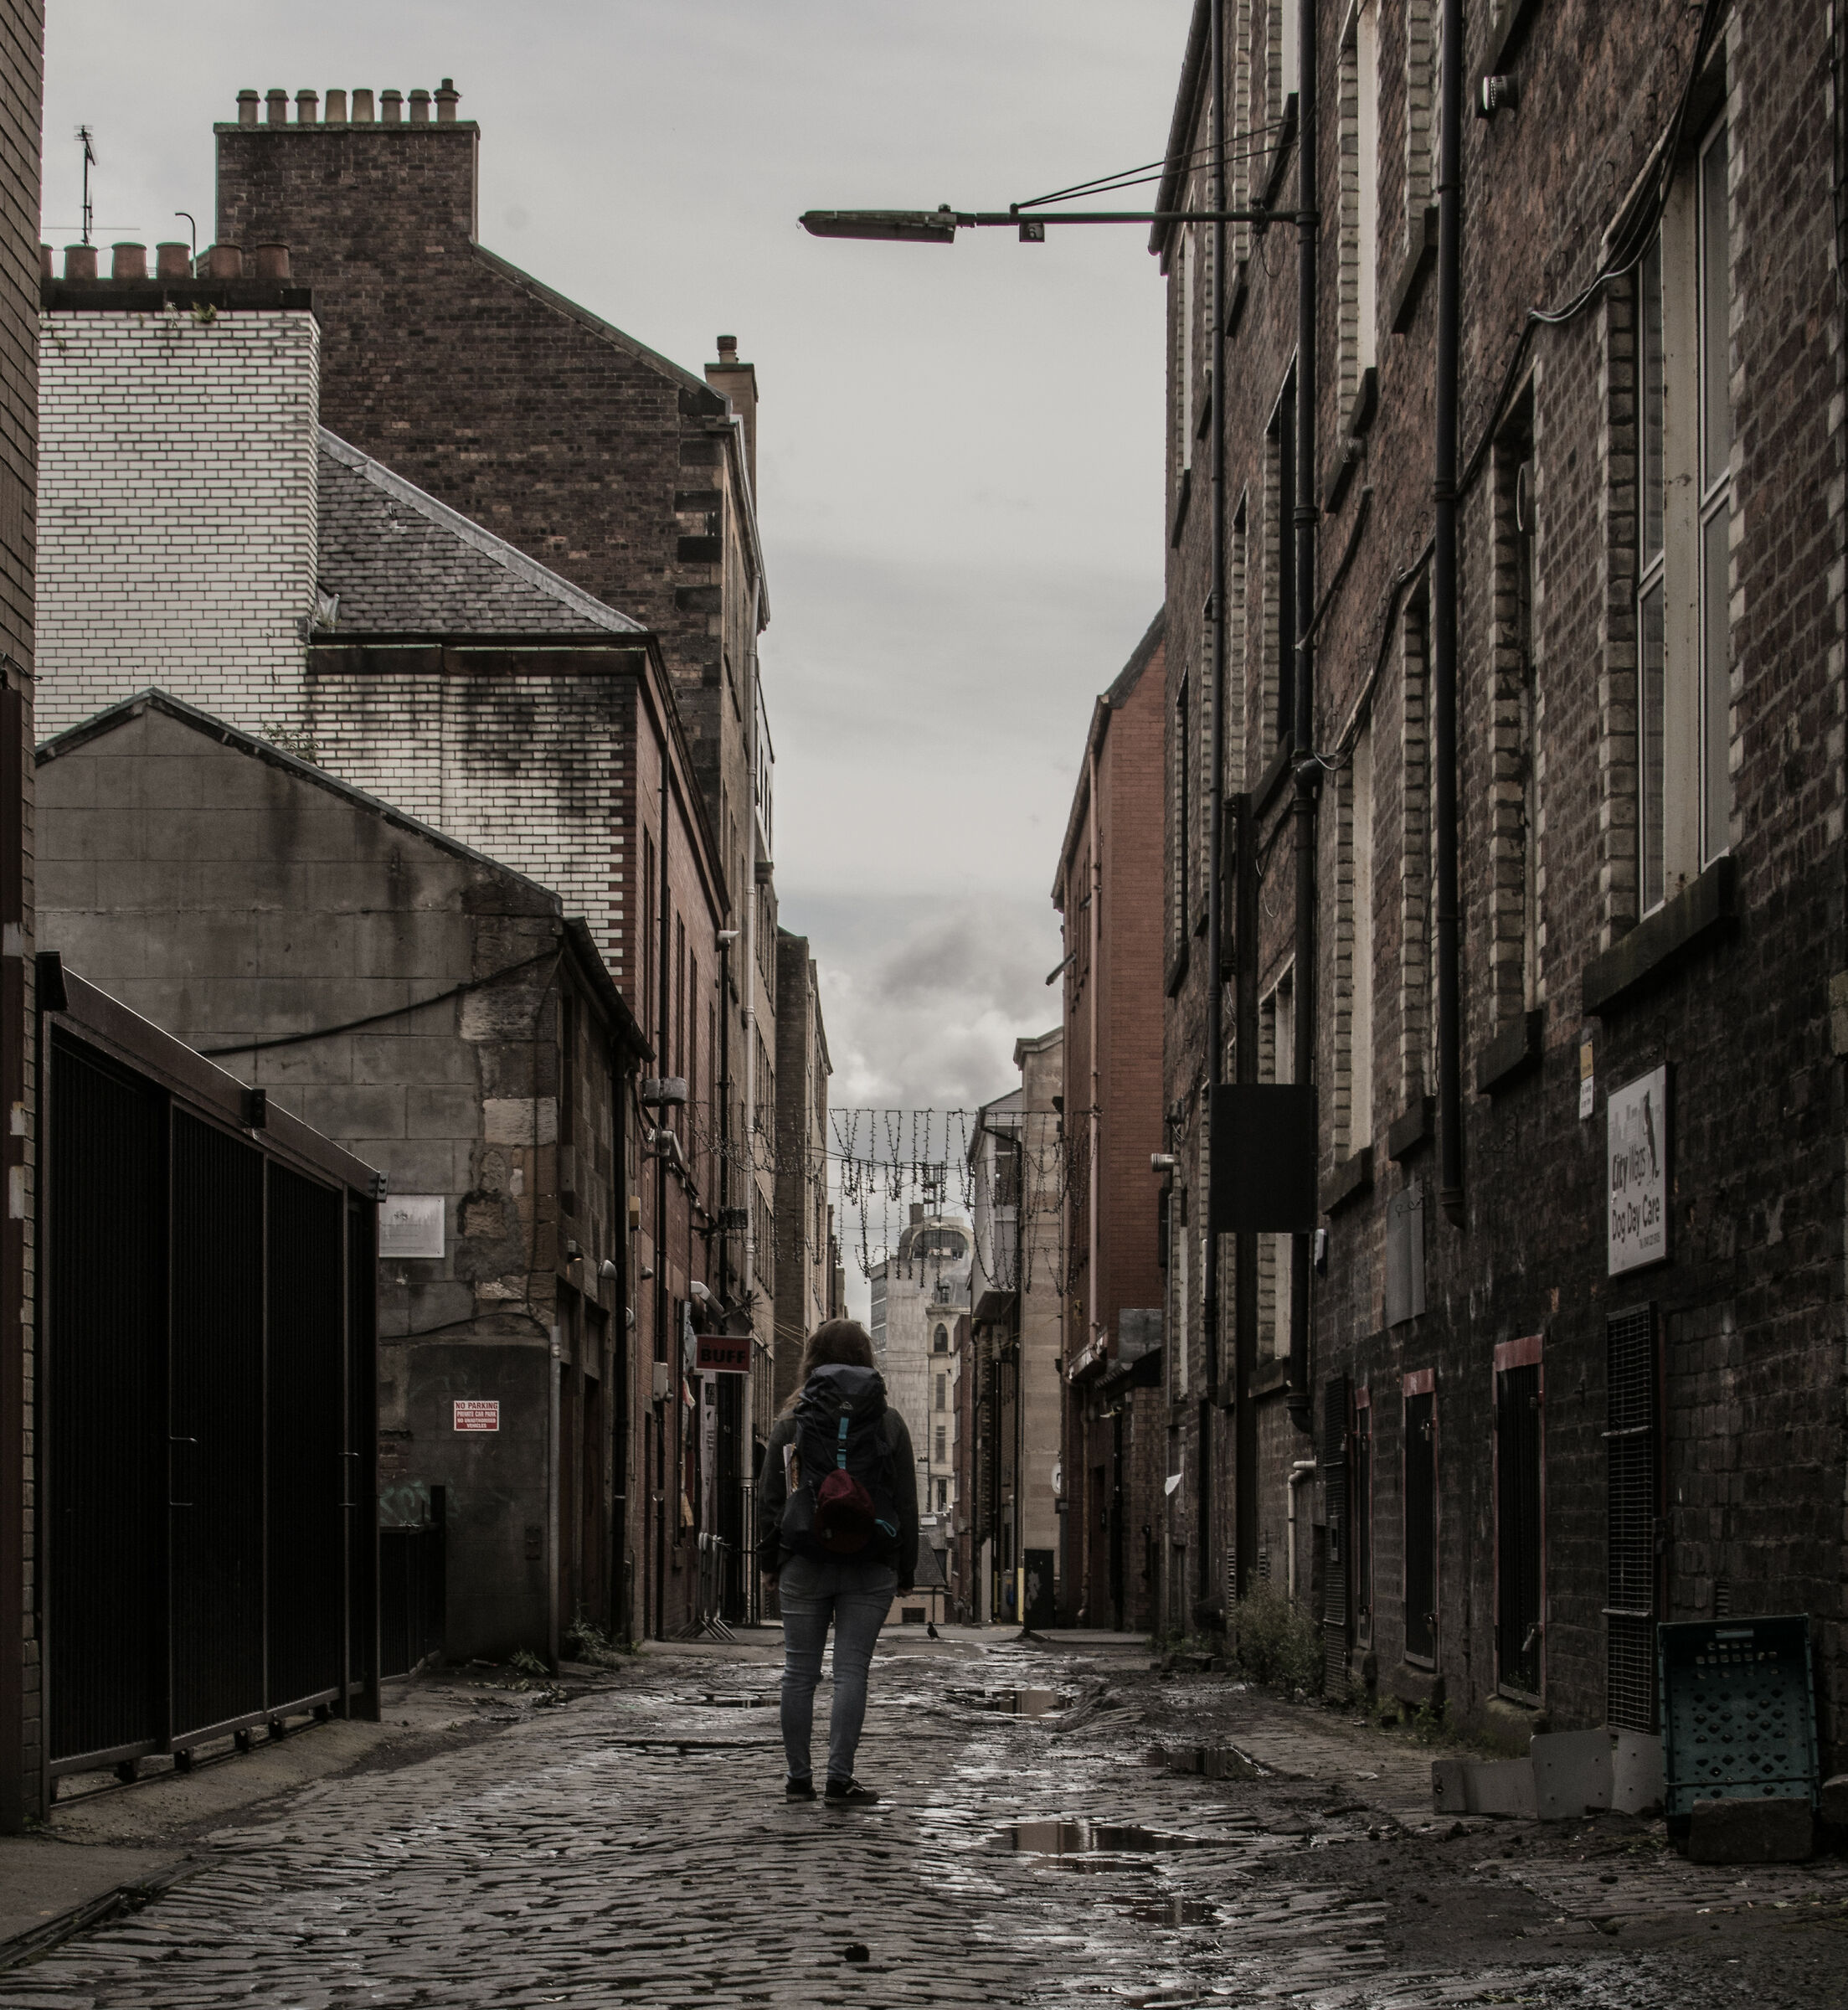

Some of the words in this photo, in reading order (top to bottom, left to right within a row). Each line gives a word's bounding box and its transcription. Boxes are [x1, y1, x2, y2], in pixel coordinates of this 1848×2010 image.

[1612, 1153, 1629, 1193] City
[1628, 1144, 1646, 1186] Wags
[1612, 1209, 1626, 1244] Dog
[1627, 1202, 1641, 1237] Day
[1642, 1193, 1660, 1228] Care
[700, 1348, 746, 1364] BUFF
